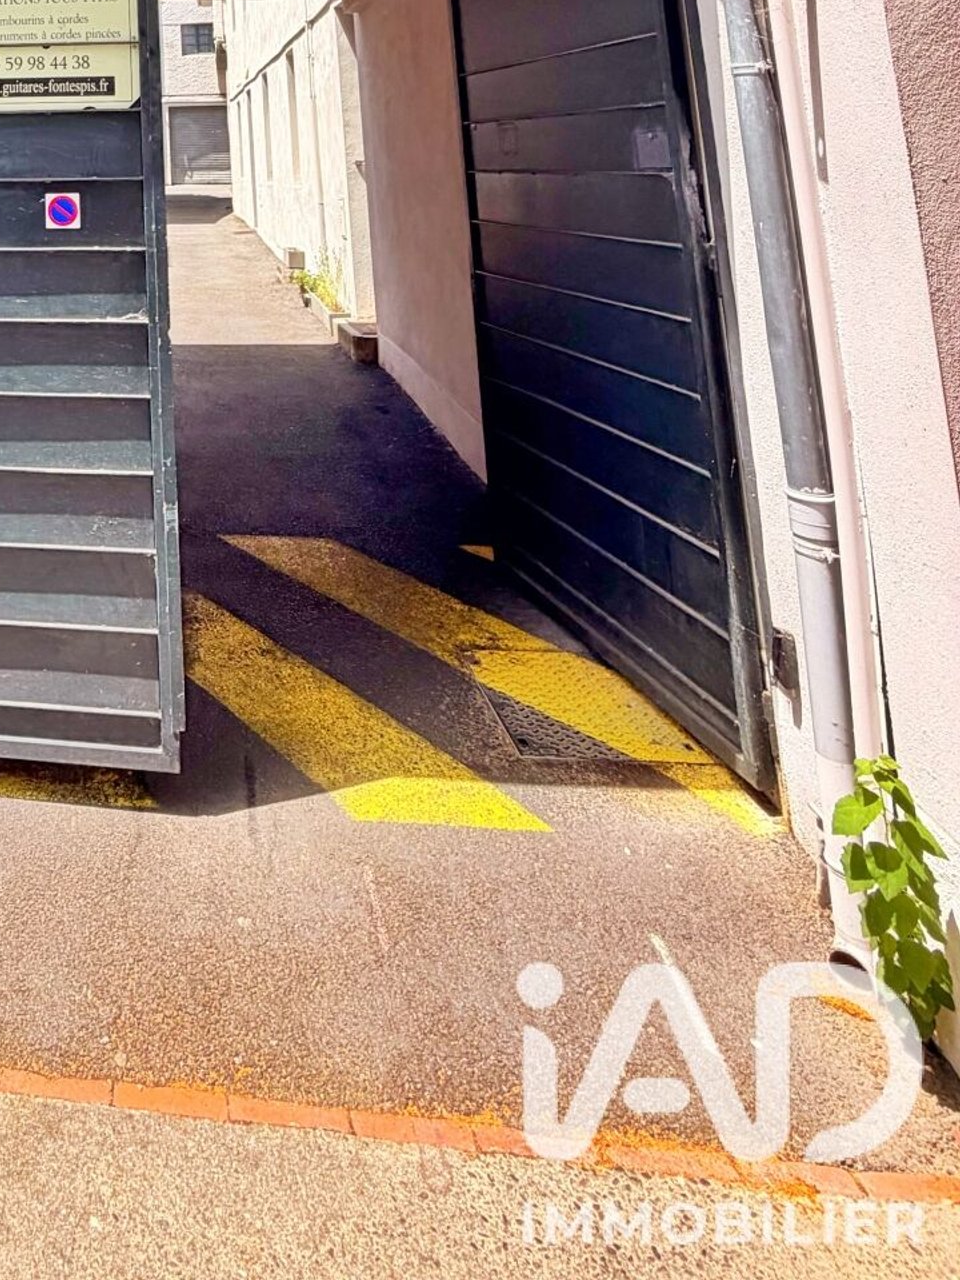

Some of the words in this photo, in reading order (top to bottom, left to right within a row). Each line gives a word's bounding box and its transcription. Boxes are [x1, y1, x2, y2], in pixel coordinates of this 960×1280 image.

[50, 28, 82, 40] cordes
[85, 29, 121, 42] pincées
[5, 56, 23, 71] 59
[27, 56, 45, 70] 98
[50, 55, 67, 70] 44
[72, 54, 90, 69] 38
